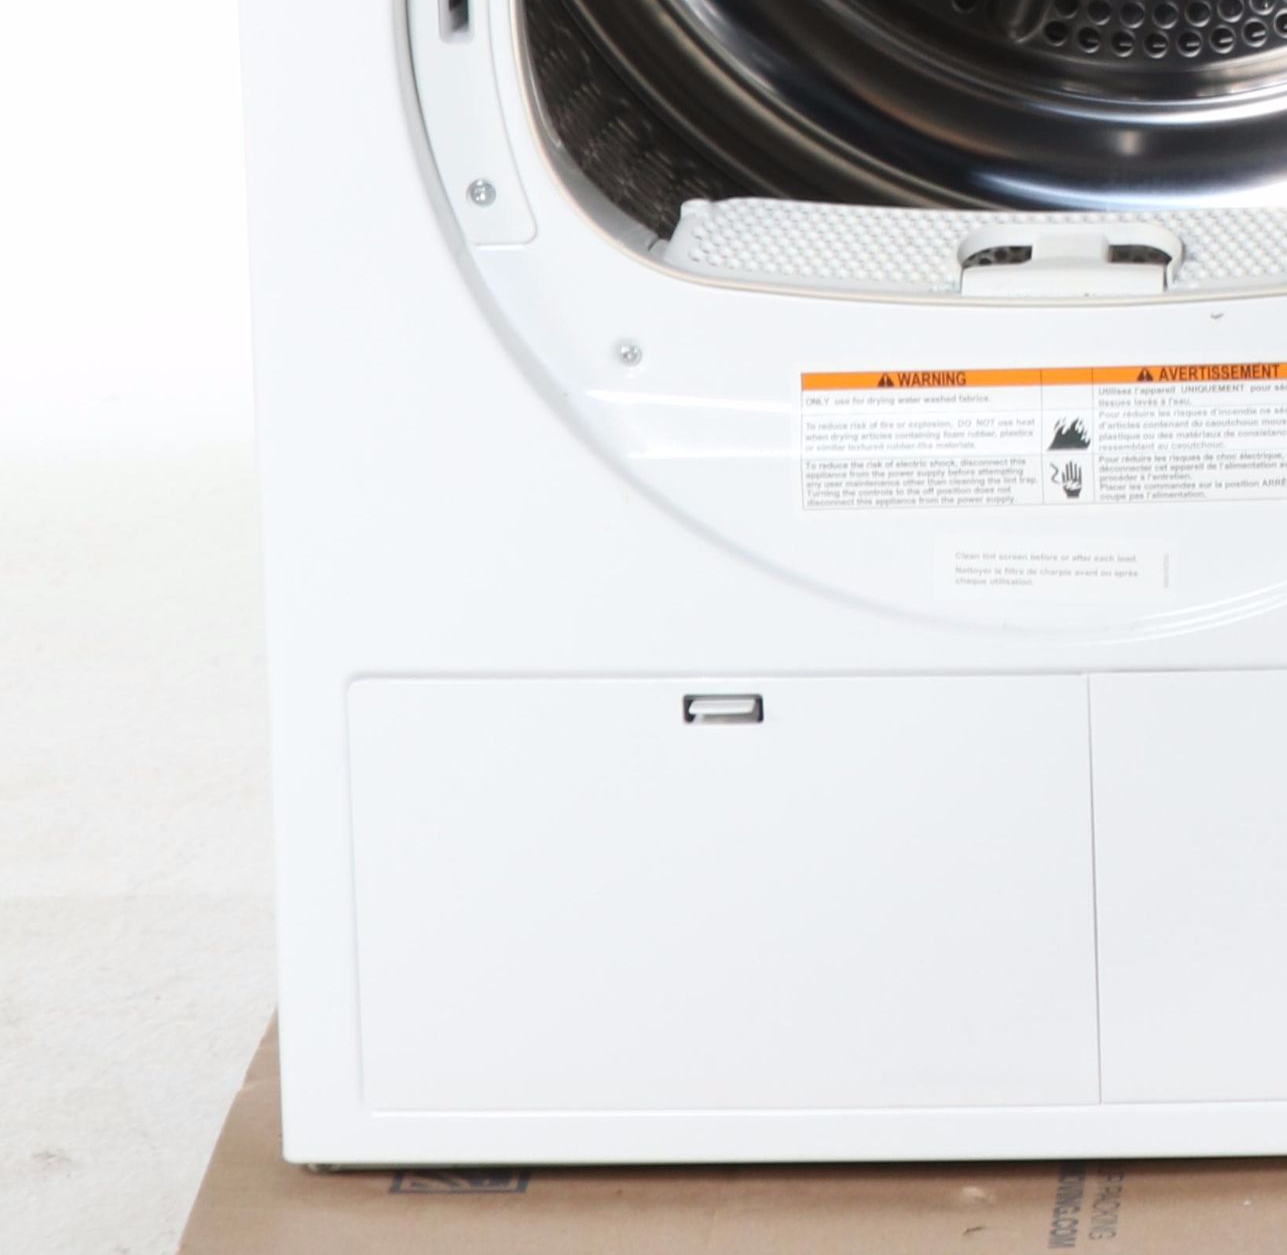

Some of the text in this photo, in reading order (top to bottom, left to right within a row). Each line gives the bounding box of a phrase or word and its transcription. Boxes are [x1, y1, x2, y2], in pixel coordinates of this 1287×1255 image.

[897, 371, 967, 387] WARNING
[1158, 364, 1280, 381] AVERTISSEMENT
[1047, 1174, 1083, 1249] OVING.COM
